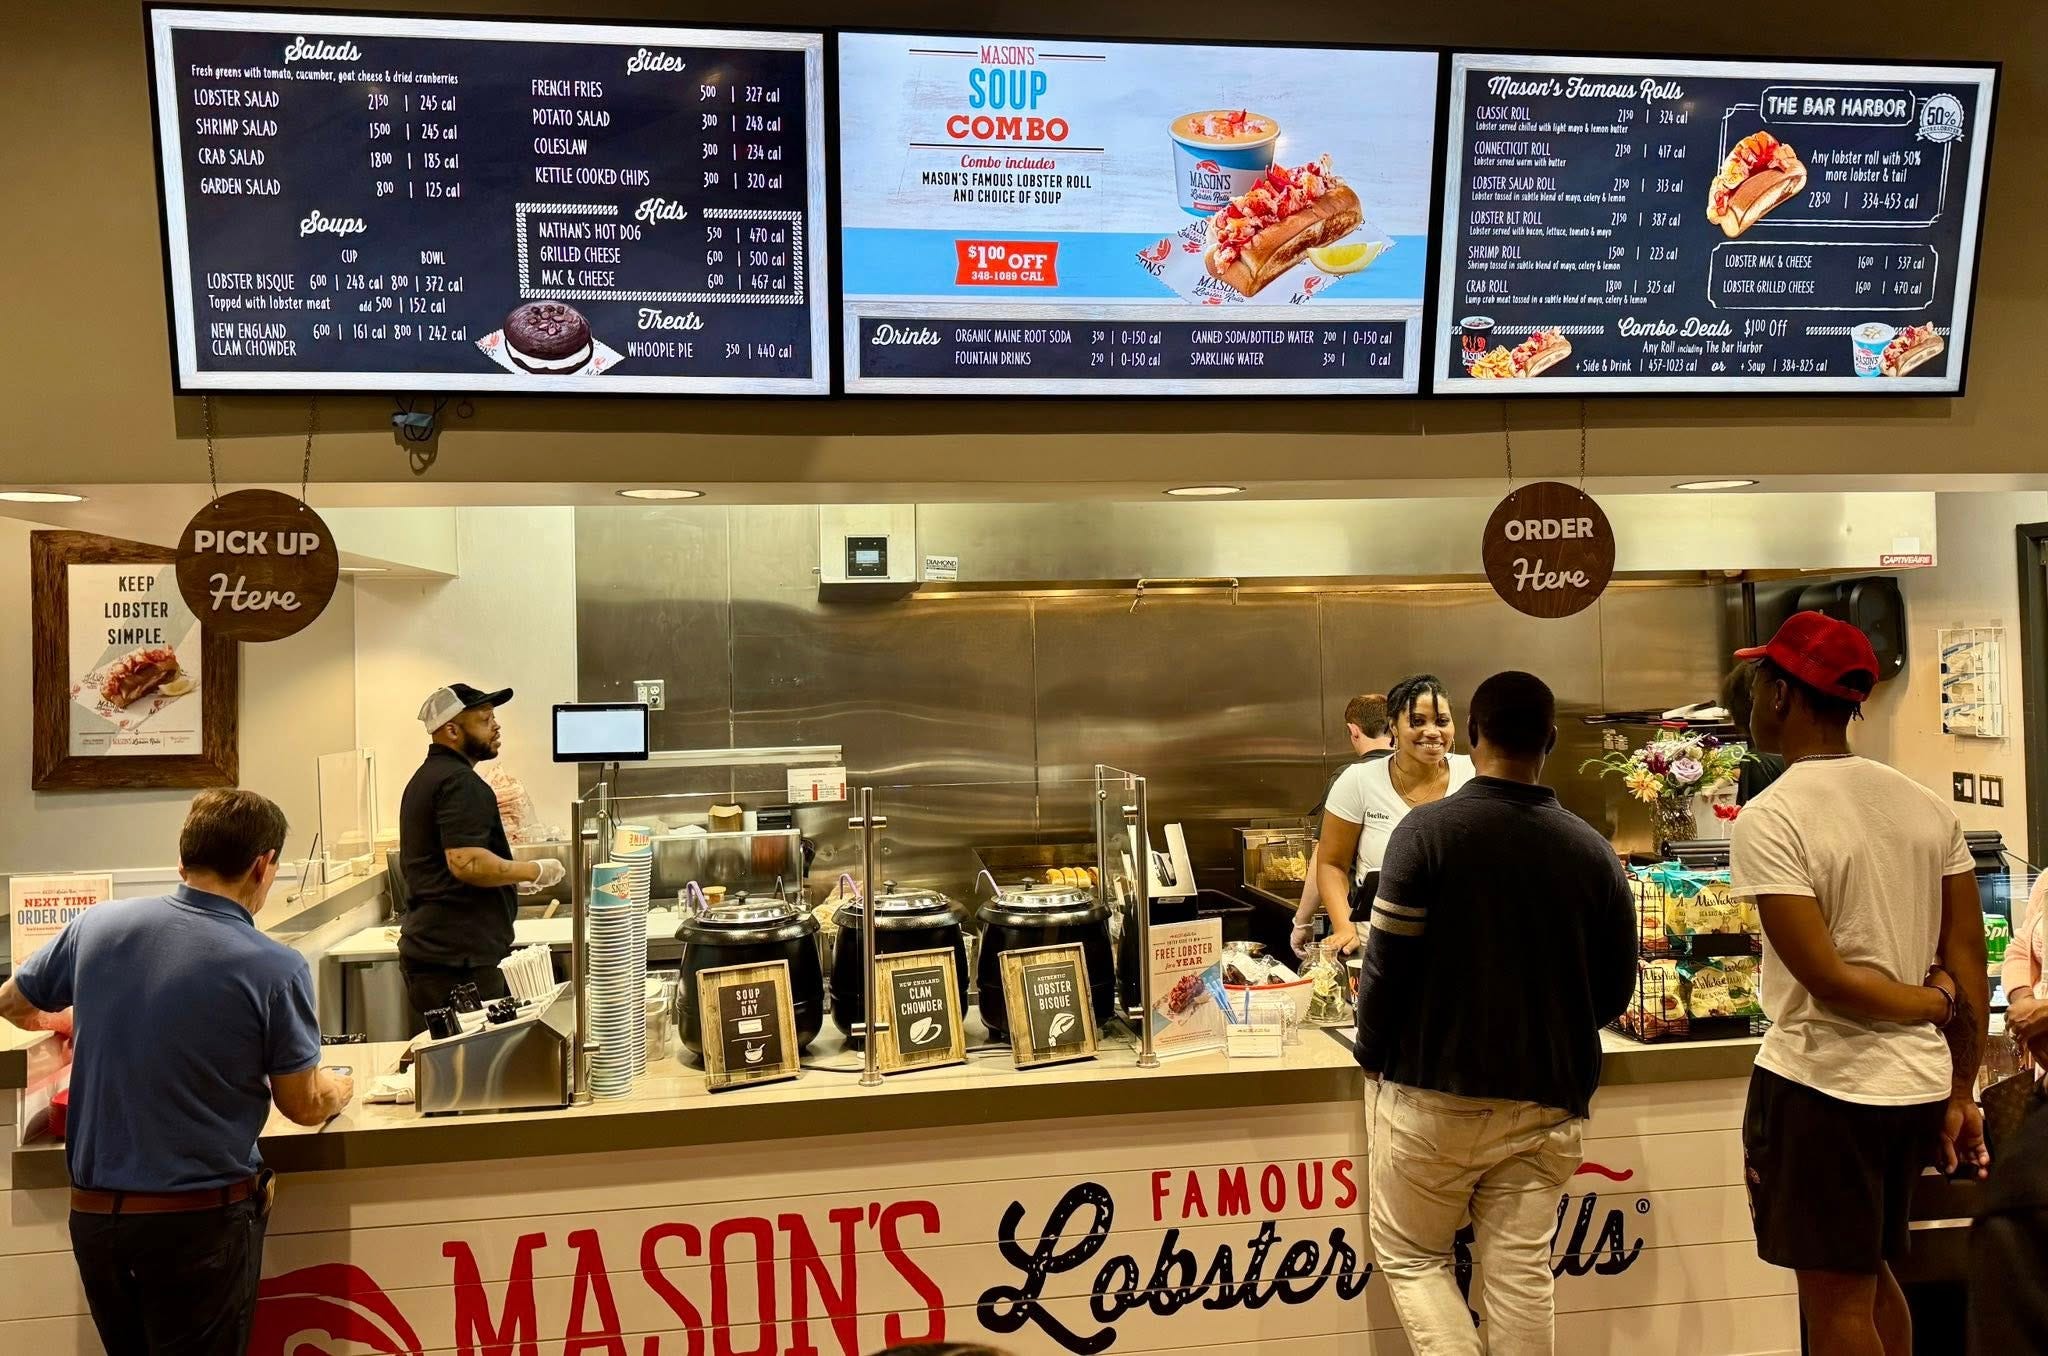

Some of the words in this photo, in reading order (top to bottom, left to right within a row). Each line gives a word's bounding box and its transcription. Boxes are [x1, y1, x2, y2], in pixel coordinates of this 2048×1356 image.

[285, 36, 362, 64] Salads
[981, 45, 1035, 65] MASON'S
[627, 48, 685, 75] Sides
[192, 65, 213, 77] Fresh
[215, 67, 241, 79] greens
[244, 68, 261, 79] with
[264, 68, 293, 81] tomato,
[296, 70, 336, 82] cucumber,
[339, 71, 355, 84] goat
[358, 71, 383, 82] cheese
[385, 72, 390, 82] &
[393, 72, 412, 83] dried
[415, 73, 458, 85] cranberries
[532, 79, 571, 96] FRENCH
[574, 81, 602, 97] FRIES
[969, 68, 1046, 110] SOUP
[1487, 76, 1563, 99] Mason's
[1566, 77, 1637, 99] Famous
[1640, 78, 1684, 104] Rolls
[194, 89, 242, 107] LOBSTER
[244, 91, 279, 108] SALAD
[1768, 96, 1797, 114] THE
[1803, 98, 1835, 116] BAR
[1841, 99, 1906, 118] HARBOR
[533, 109, 573, 126] POTATO
[577, 110, 610, 127] SALAD
[1477, 106, 1508, 120] CLASSIC
[1511, 107, 1530, 121] ROLL
[1927, 106, 1956, 126] 50%
[196, 119, 239, 135] SHRIMP
[242, 120, 278, 136] SALAD
[946, 114, 1069, 141] COMBO
[534, 138, 587, 155] COLESLAW
[1475, 141, 1528, 155] CONNECTICUT
[1531, 142, 1550, 155] ROLL
[198, 149, 226, 165] CRAB
[230, 149, 265, 166] SALAD
[961, 154, 1001, 169] Combo
[1005, 156, 1055, 170] includes
[1811, 150, 1828, 166] Any
[1832, 150, 1862, 164] lobster
[1865, 152, 1879, 165] roll
[1882, 151, 1900, 165] with
[1903, 151, 1921, 166] 50%
[536, 167, 573, 183] KETTLE
[576, 168, 617, 185] COOKED
[620, 169, 650, 186] CHIPS
[922, 172, 968, 185] MASON'S
[973, 173, 1013, 187] FAMOUS
[1017, 174, 1062, 188] LOBSTER
[1066, 175, 1091, 189] ROLL
[1473, 177, 1506, 189] LOBSTER
[1509, 177, 1533, 190] SALAD
[1536, 177, 1556, 190] ROLL
[1825, 170, 1847, 182] more
[1850, 168, 1881, 182] lobster
[1884, 169, 1889, 182] &
[1892, 169, 1906, 182] tail
[201, 178, 242, 194] GARDEN
[246, 179, 280, 195] SALAD
[954, 189, 973, 202] AND
[978, 189, 1015, 203] CHOICE
[1019, 191, 1031, 203] OF
[1035, 191, 1061, 204] SOUP
[635, 198, 687, 225] Kids
[1471, 211, 1504, 224] LOBSTER
[1506, 211, 1520, 224] BLT
[1522, 212, 1542, 225] ROLL
[300, 209, 367, 237] Soups
[539, 223, 591, 240] NATHAN'S
[595, 224, 617, 240] HOT
[620, 224, 641, 241] DOG
[341, 250, 358, 263] CUP
[421, 251, 445, 265] BOWL
[540, 247, 581, 262] GRILLED
[584, 248, 620, 264] CHEESE
[1468, 246, 1499, 258] SHRIMP
[1502, 246, 1521, 258] ROLL
[1008, 255, 1047, 269] OFF
[1725, 255, 1756, 268] LOBSTER
[1759, 256, 1775, 268] MAC
[1778, 256, 1783, 268] &
[1786, 256, 1812, 268] CHEESE
[207, 273, 252, 289] LOBSTER
[257, 274, 294, 290] BISQUE
[542, 270, 564, 285] MAC
[568, 270, 575, 286] &
[579, 271, 615, 287] CHEESE
[971, 271, 1017, 281] 348-1089
[1020, 271, 1044, 281] CAL
[1466, 280, 1486, 293] CRAB
[1489, 280, 1508, 293] ROLL
[1723, 280, 1754, 292] LOBSTER
[1757, 280, 1786, 293] GRILLED
[1789, 281, 1814, 294] CHEESE
[638, 308, 703, 331] Treats
[1618, 316, 1678, 337] Combo
[1680, 317, 1732, 337] Deals
[211, 323, 234, 338] NEW
[238, 323, 286, 339] ENGLAND
[872, 324, 941, 346] Drinks
[956, 329, 991, 342] ORGANIC
[994, 329, 1022, 342] MAINE
[1025, 329, 1046, 343] ROOT
[1049, 330, 1071, 343] SODA
[1192, 331, 1222, 344] CANNED
[1225, 331, 1284, 344] SODA/BOTTLED
[1288, 331, 1314, 344] WATER
[212, 340, 241, 356] CLAM
[245, 341, 296, 356] CHOWDER
[627, 342, 674, 358] WHOOPIE
[678, 342, 693, 358] PIE
[1643, 341, 1657, 354] Any
[1661, 341, 1675, 353] Roll
[1678, 344, 1702, 355] including
[1706, 341, 1719, 353] The
[1721, 341, 1734, 353] Bar
[1736, 341, 1763, 353] Harbor
[956, 351, 998, 365] FOUNTAIN
[1001, 352, 1031, 365] DRINKS
[1190, 352, 1234, 366] SPARKLING
[1237, 352, 1264, 366] WATER
[1504, 518, 1594, 541] ORDER
[194, 530, 268, 554] PICK
[276, 532, 320, 556] UP
[1512, 558, 1590, 591] Here
[119, 576, 154, 592] KEEP
[209, 573, 301, 611] Here
[104, 602, 168, 619] LOBSTER
[108, 628, 166, 645] SIMPLE.
[25, 898, 60, 907] NEXT
[64, 896, 96, 905] TIME
[17, 909, 56, 925] ORDER
[1156, 948, 1174, 960] FREE
[1178, 943, 1212, 957] LOBSTER
[1176, 957, 1202, 967] YEAR
[736, 988, 760, 1000] SOUP
[910, 986, 931, 999] CLAM
[1034, 981, 1071, 996] LOBSTER
[741, 1004, 758, 1016] DAY
[901, 999, 942, 1015] CHOWDER
[1039, 995, 1070, 1010] BISQUE
[1151, 1158, 1358, 1221] FAMOUS
[442, 1199, 946, 1356] MASON'S
[977, 1182, 1373, 1356] Lobster
